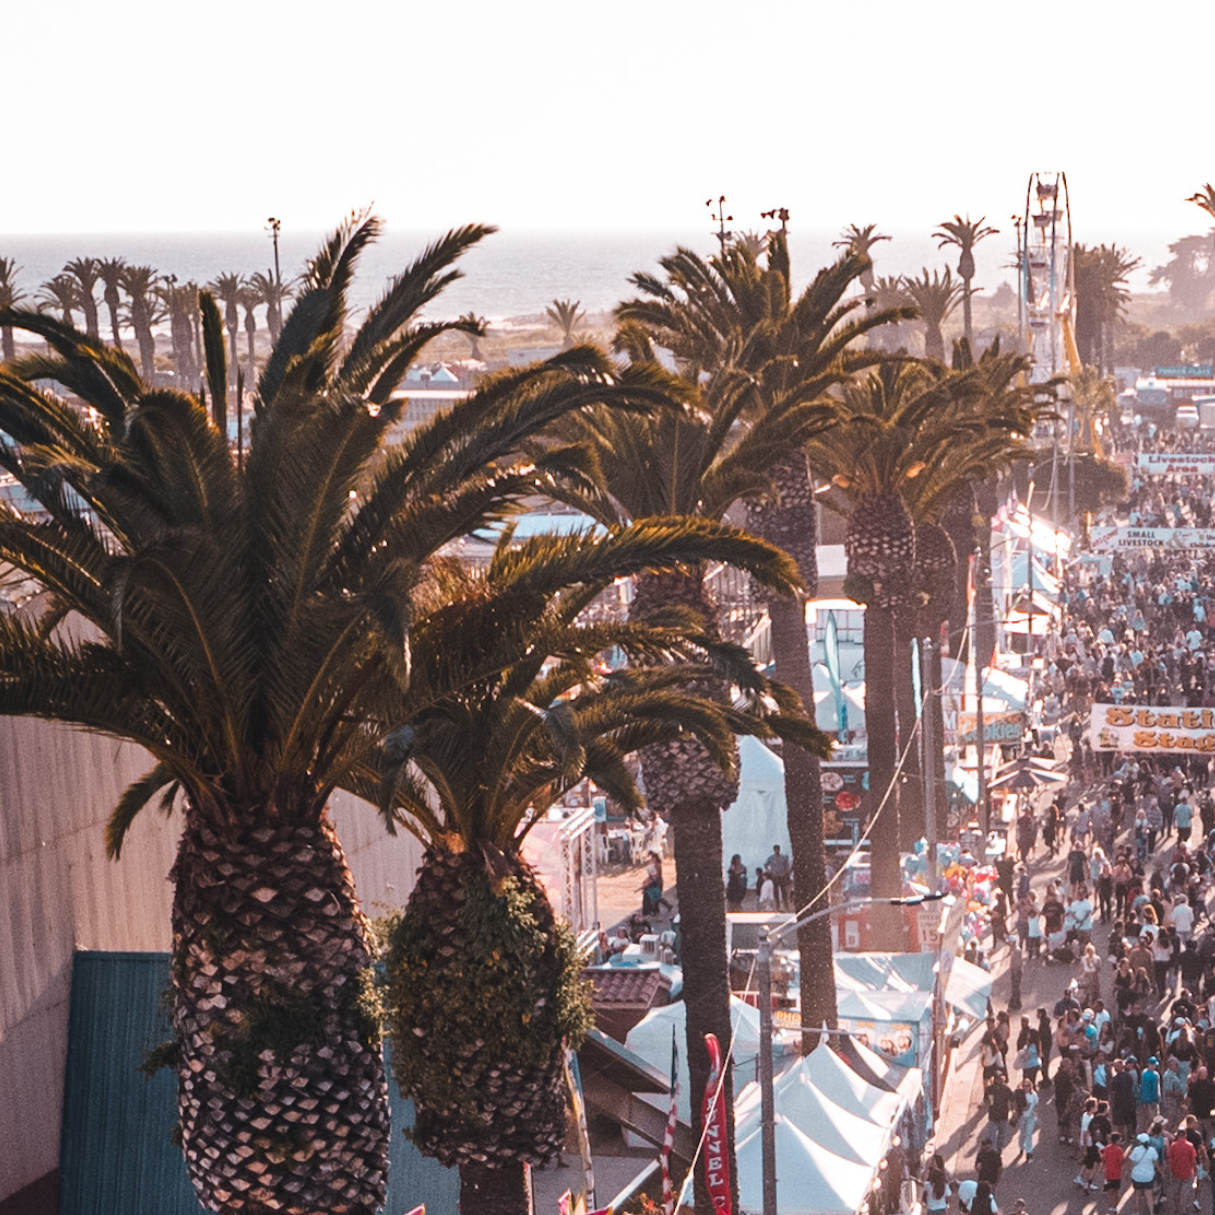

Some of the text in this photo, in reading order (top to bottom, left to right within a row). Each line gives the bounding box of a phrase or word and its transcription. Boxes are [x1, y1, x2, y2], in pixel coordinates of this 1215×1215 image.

[1148, 456, 1215, 464] Livestock
[1166, 465, 1199, 473] Area
[1127, 530, 1155, 538] SMALL
[1118, 539, 1164, 547] LIVESTOCK
[922, 929, 938, 942] 15
[776, 1010, 802, 1021] PHO
